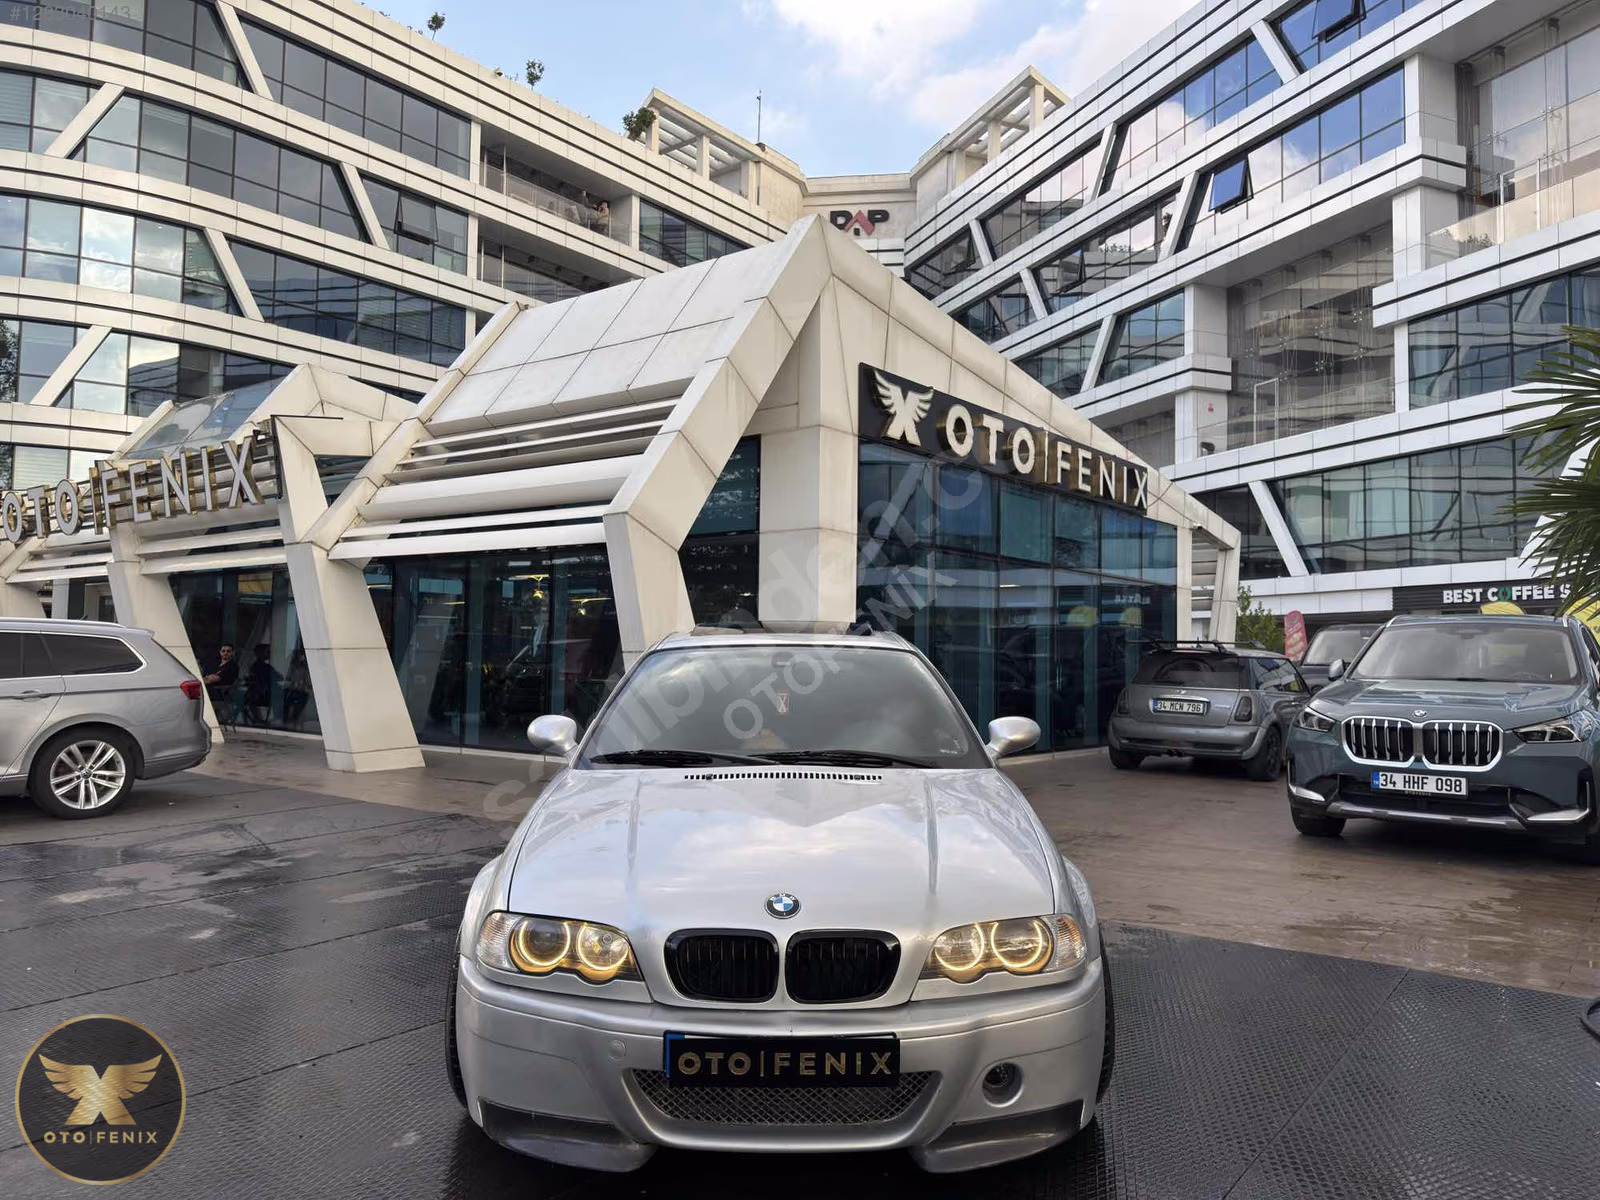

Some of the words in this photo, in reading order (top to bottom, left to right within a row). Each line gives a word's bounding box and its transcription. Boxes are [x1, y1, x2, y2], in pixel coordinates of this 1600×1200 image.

[830, 209, 890, 236] DAP
[1443, 588, 1482, 603] BEST
[1487, 584, 1554, 602] COFFEE
[1158, 701, 1167, 710] 34
[1380, 773, 1397, 788] 34
[1403, 775, 1429, 790] HHF
[1435, 778, 1462, 793] 098
